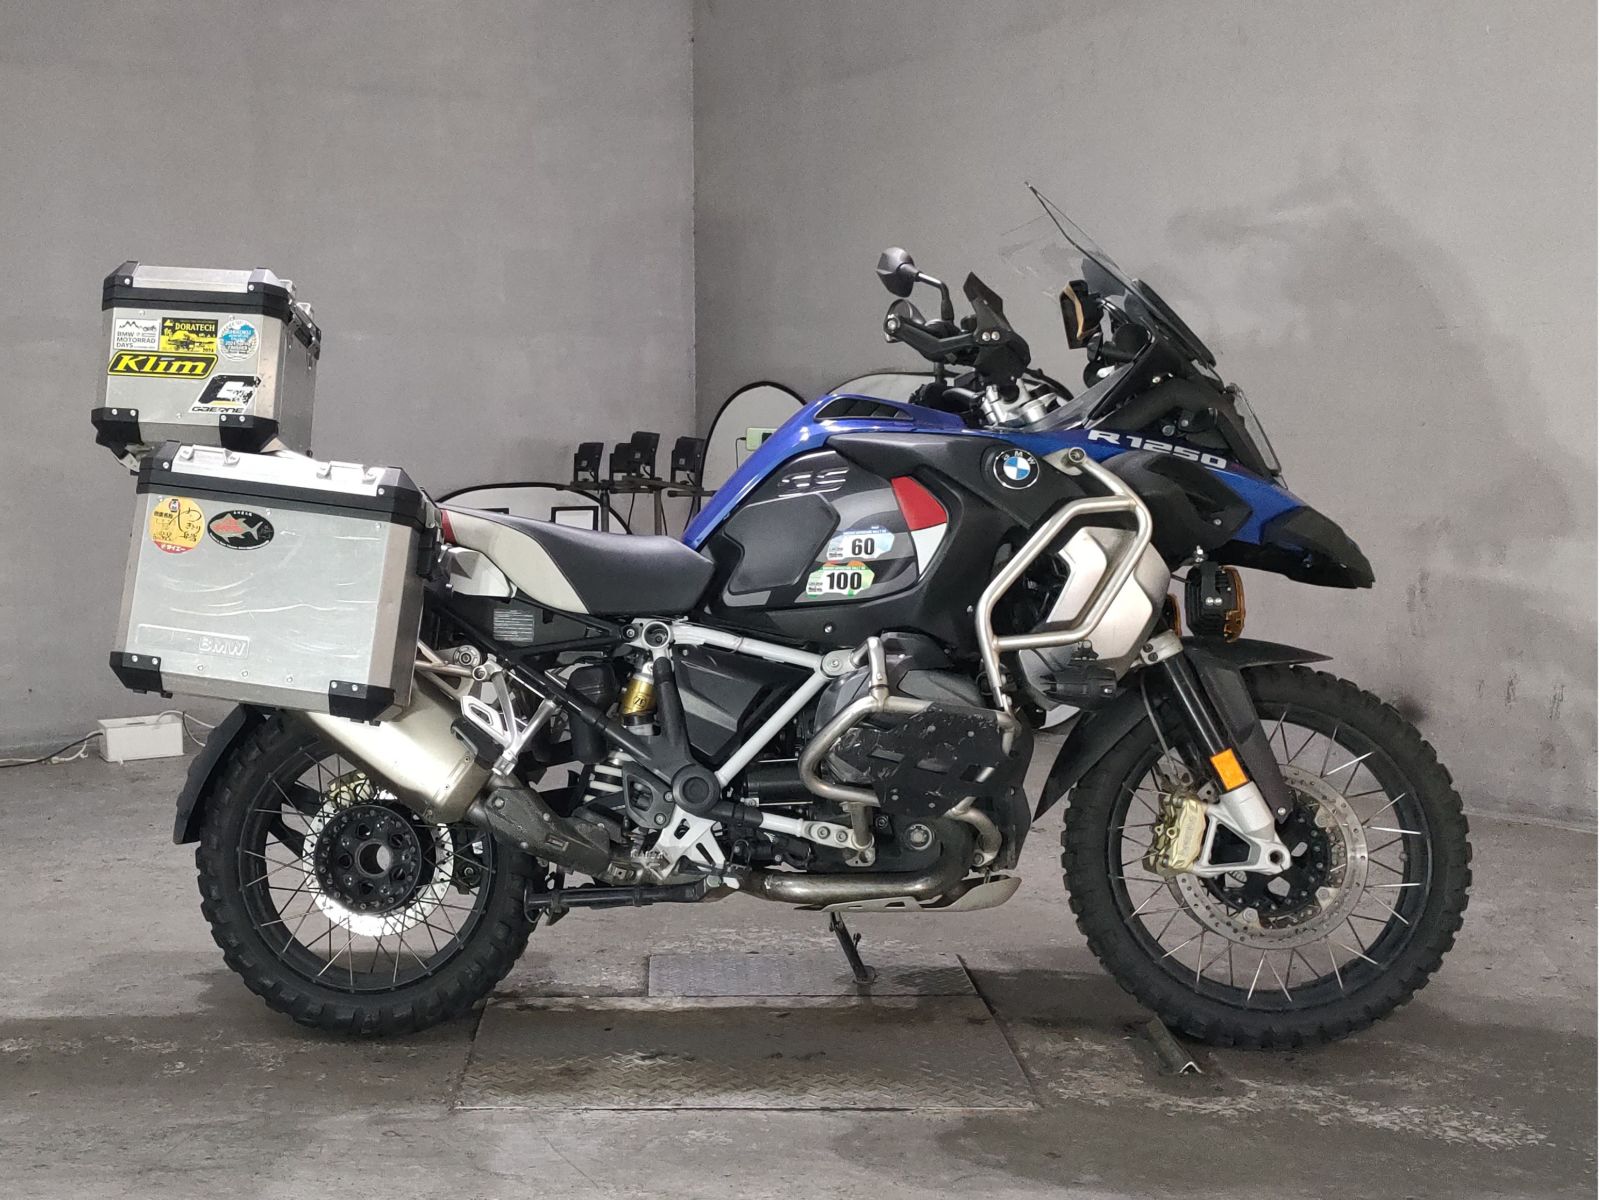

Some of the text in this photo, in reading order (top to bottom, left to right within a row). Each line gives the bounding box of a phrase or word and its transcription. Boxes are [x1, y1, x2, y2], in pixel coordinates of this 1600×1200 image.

[175, 322, 215, 332] DORATECH
[114, 354, 207, 375] Klim
[1088, 429, 1228, 469] R 1250
[851, 537, 875, 556] 60
[826, 571, 862, 590] 100
[199, 636, 247, 656] BMW
